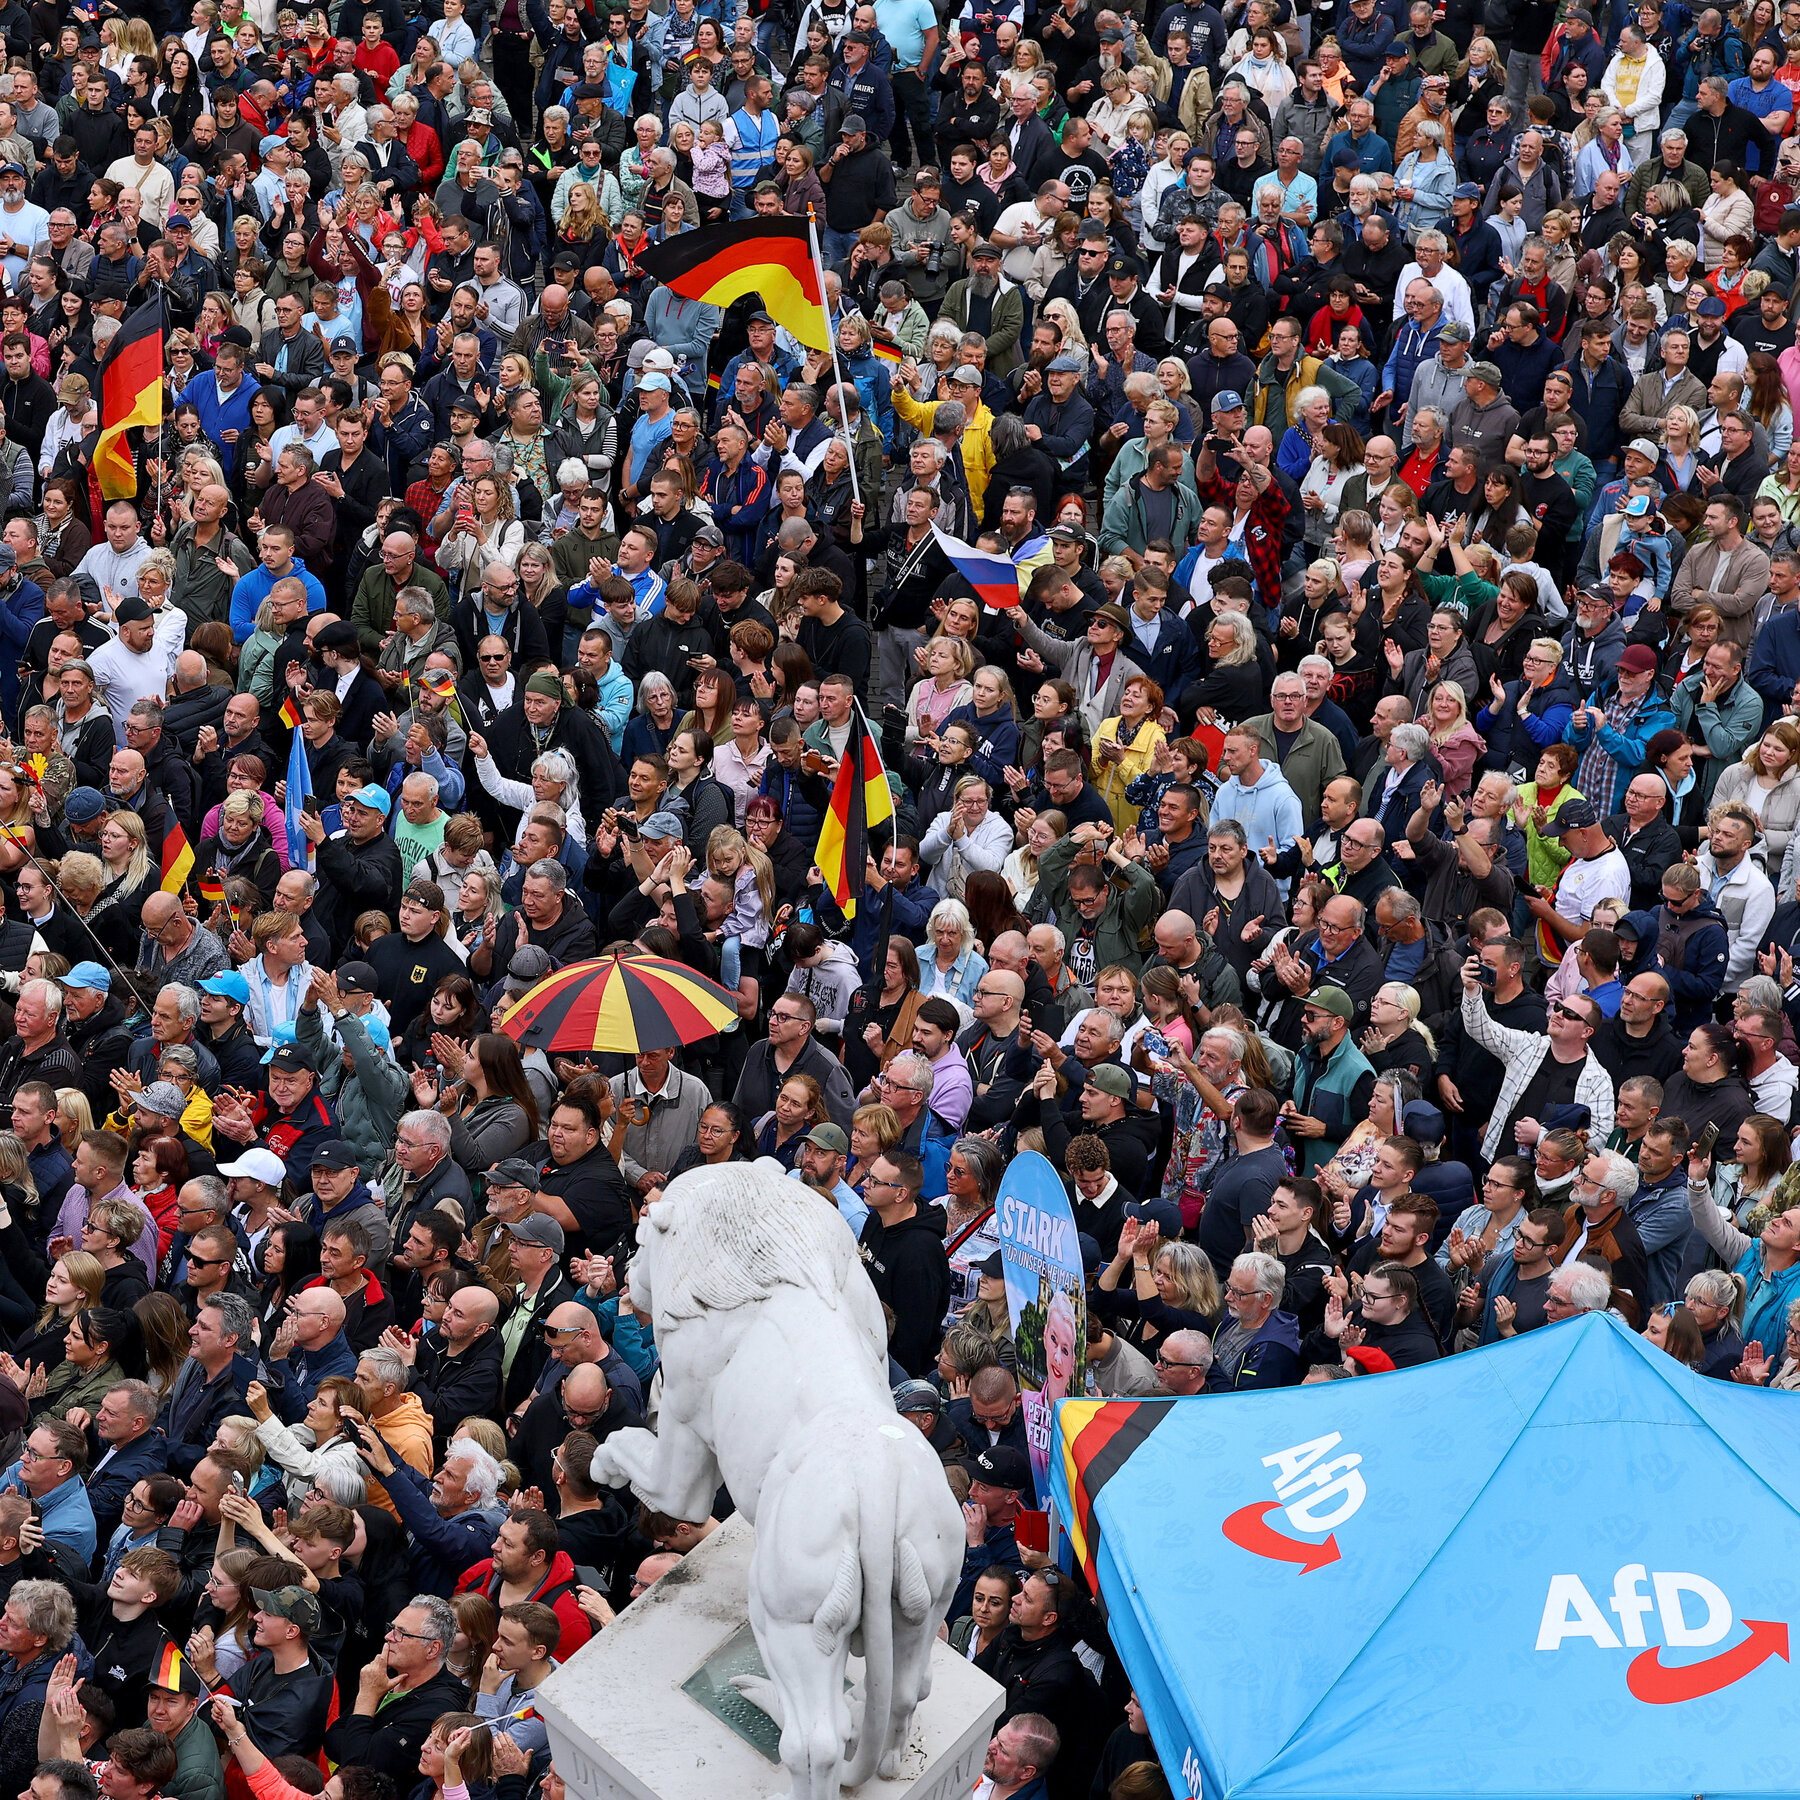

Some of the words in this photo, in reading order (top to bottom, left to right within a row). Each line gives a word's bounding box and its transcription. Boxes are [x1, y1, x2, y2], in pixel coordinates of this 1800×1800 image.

[1169, 23, 1186, 32] CAMP
[1192, 24, 1211, 35] DAVID
[1069, 955, 1098, 985] ILERS
[278, 1048, 293, 1057] CAT
[1001, 1196, 1067, 1262] STARK
[1004, 1241, 1018, 1264] FÜR
[1018, 1250, 1047, 1278] UNSERE
[1047, 1263, 1075, 1290] HEIMAT
[1261, 1431, 1367, 1533] AfD
[1535, 1563, 1733, 1651] AfD
[1181, 1745, 1203, 1800] AfD
